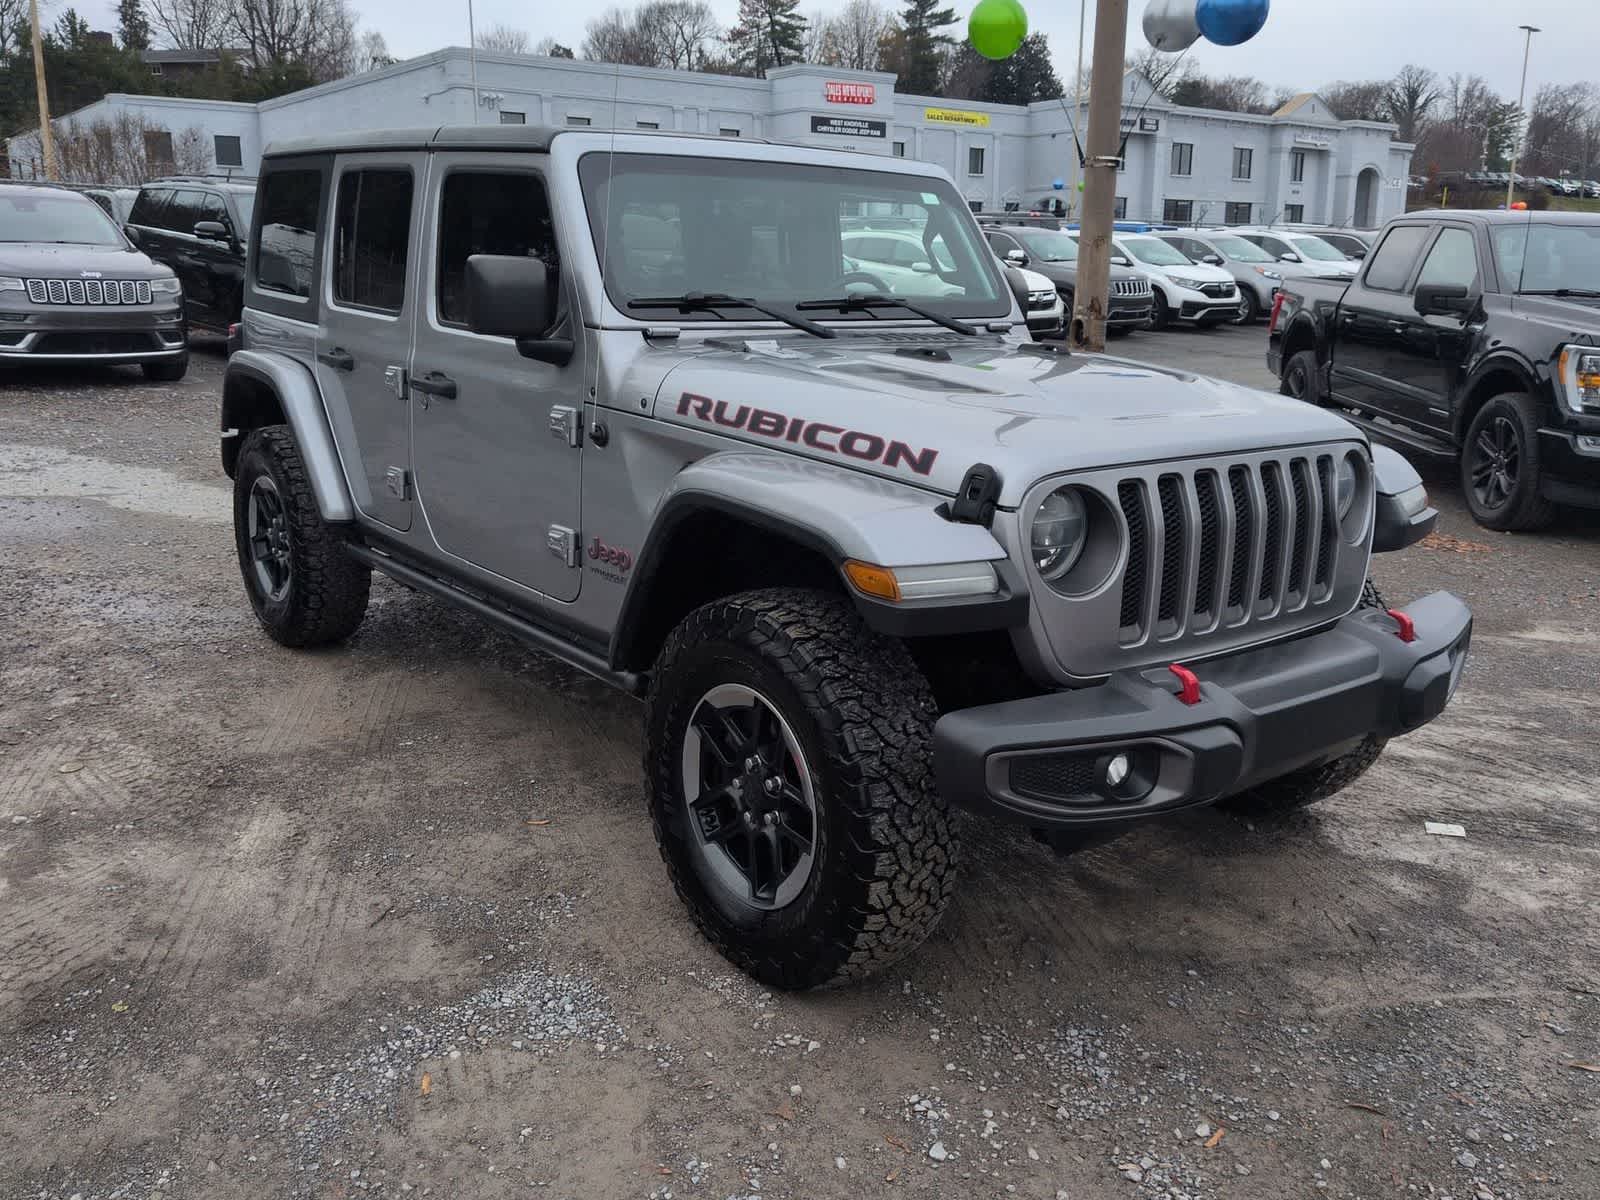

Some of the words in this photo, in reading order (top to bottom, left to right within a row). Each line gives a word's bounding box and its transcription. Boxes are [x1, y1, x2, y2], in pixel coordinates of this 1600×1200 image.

[927, 112, 943, 121] SALES
[817, 125, 841, 134] CHRYSLER
[676, 391, 939, 476] RUBICON
[587, 536, 632, 573] Jeep
